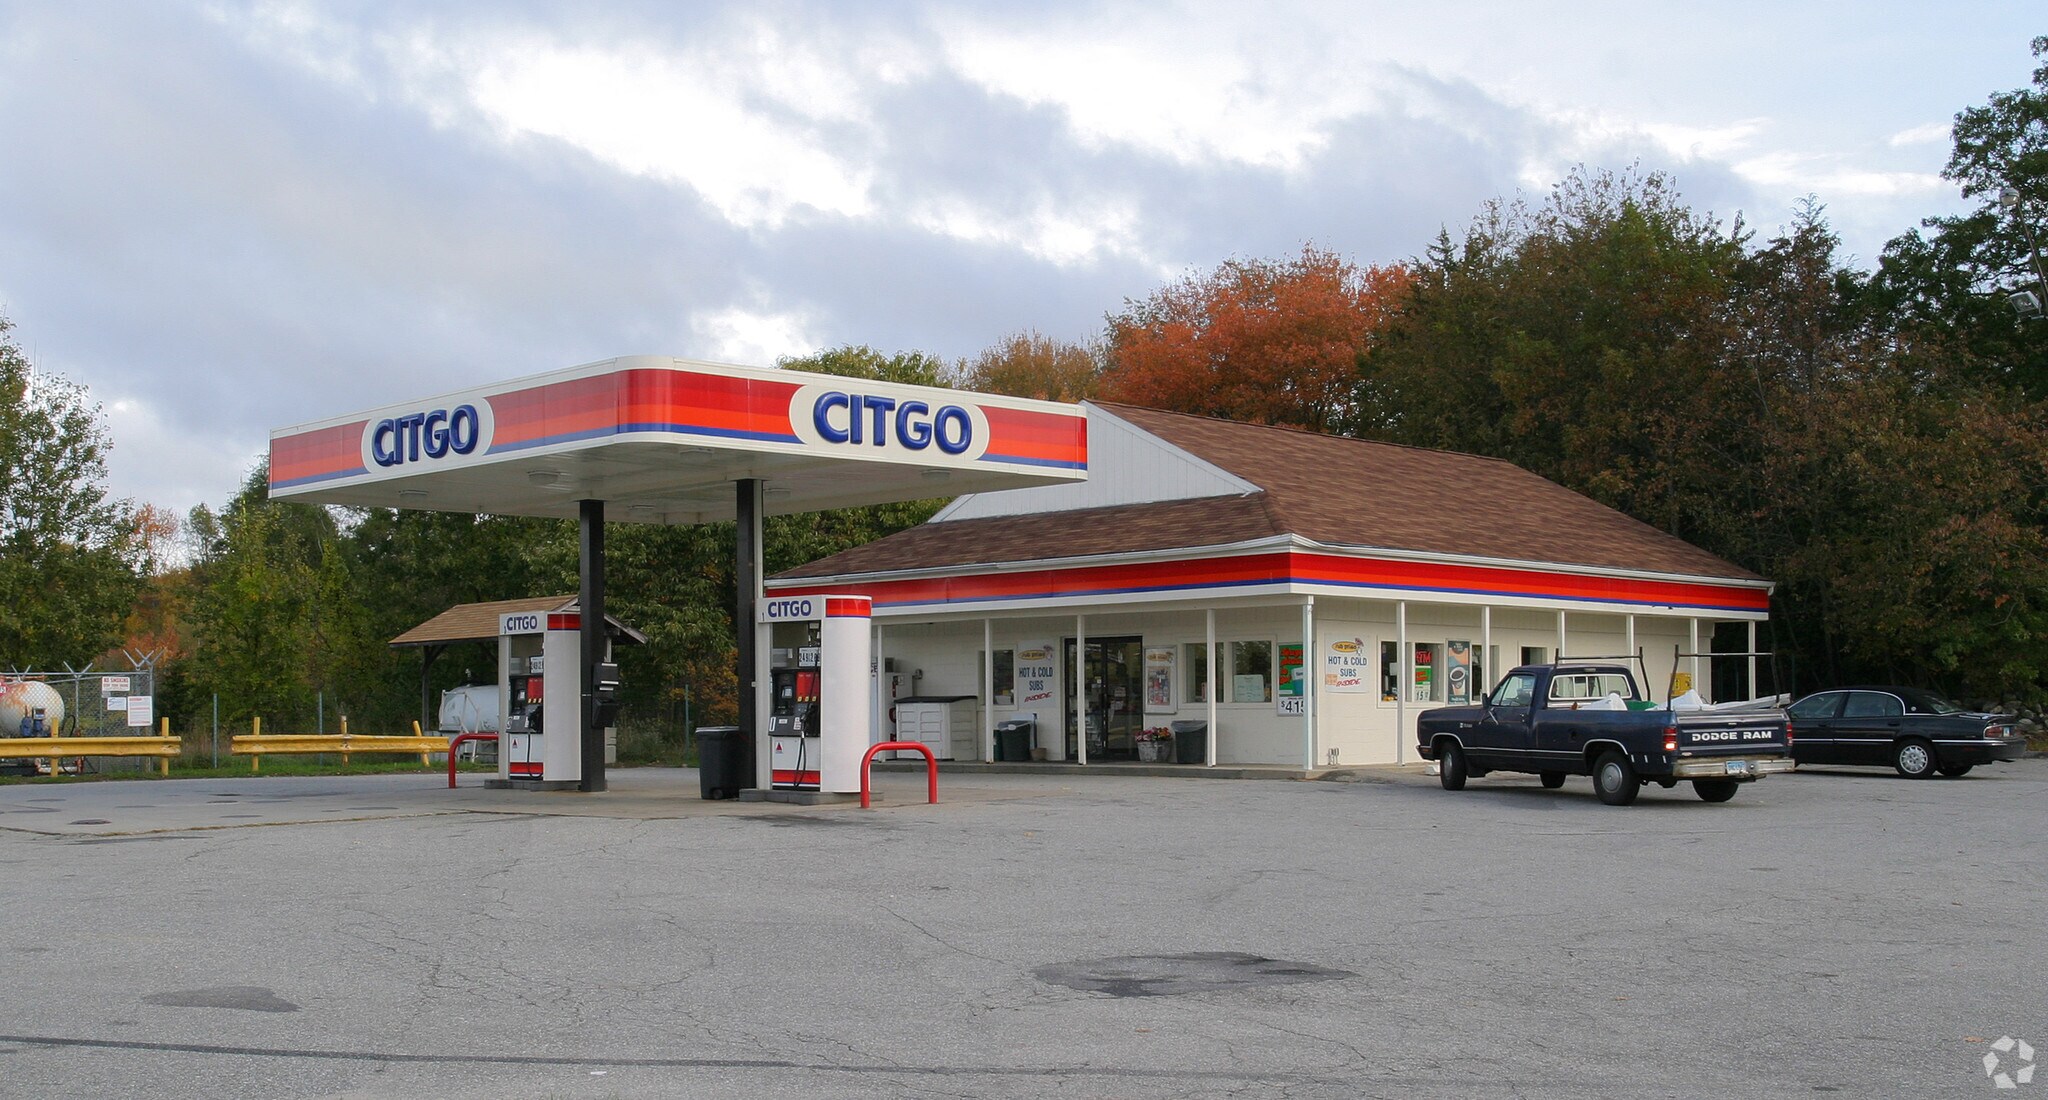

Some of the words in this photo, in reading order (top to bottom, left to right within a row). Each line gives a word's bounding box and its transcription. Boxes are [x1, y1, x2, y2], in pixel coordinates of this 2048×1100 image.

[813, 391, 972, 455] CITGO
[371, 404, 479, 467] CITGO
[767, 600, 812, 618] CITGO
[506, 615, 538, 631] CITGO
[1328, 656, 1341, 665] HOT
[1344, 657, 1349, 665] &
[1350, 656, 1368, 666] COLD
[1019, 667, 1030, 678] HOT
[1032, 667, 1037, 678] &
[1038, 667, 1054, 678] COLD
[1340, 668, 1357, 677] SUBS
[1029, 680, 1044, 691] SUBS
[1692, 732, 1738, 741] DODGE
[1743, 731, 1772, 740] RAM
